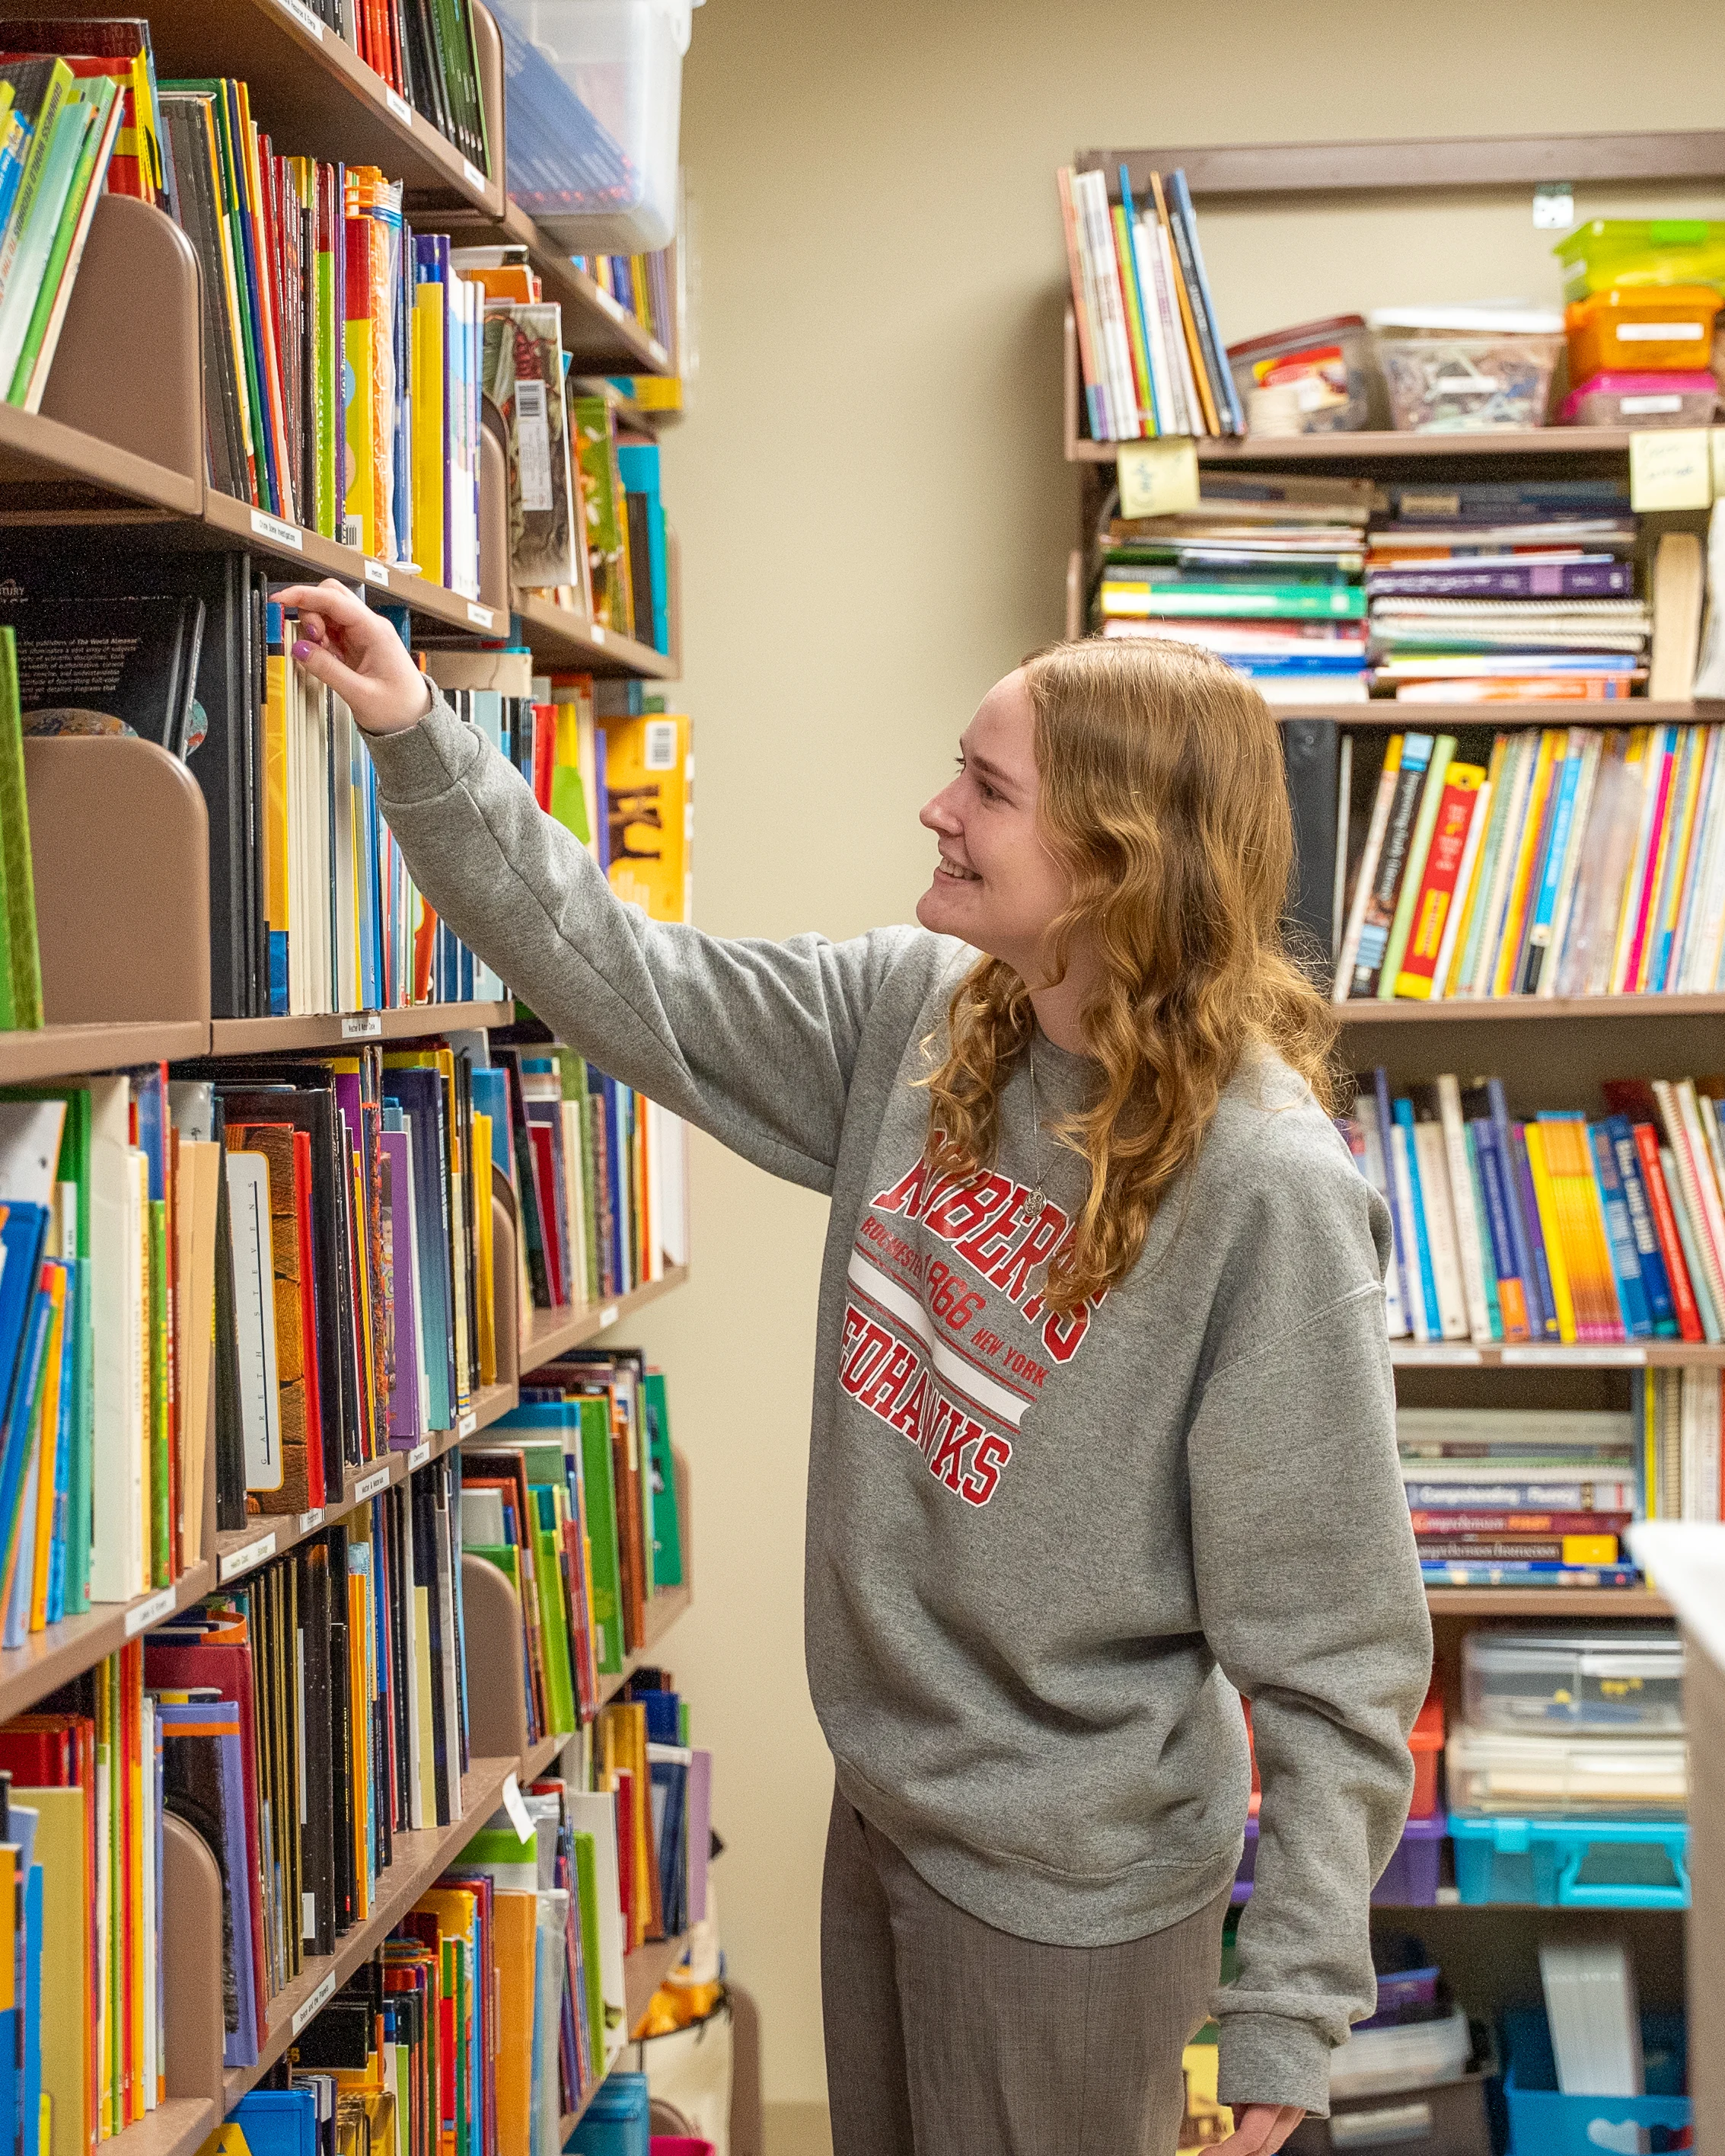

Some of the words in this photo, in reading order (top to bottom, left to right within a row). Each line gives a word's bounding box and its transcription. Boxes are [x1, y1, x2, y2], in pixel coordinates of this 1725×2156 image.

[41, 81, 63, 139] GUINNESS
[29, 138, 46, 180] WORLD
[13, 184, 33, 238] RECORDS
[259, 519, 268, 531] Crime
[269, 521, 277, 534] Scene
[277, 528, 295, 543] Investigations
[0, 587, 24, 596] TURY
[247, 1181, 261, 1318] STEVENS
[859, 1215, 927, 1280] ROCHESTE
[970, 1327, 1004, 1357] NEW
[1002, 1346, 1050, 1389] YORK
[255, 1351, 269, 1466] GARETH
[837, 1296, 1014, 1508] EDHAWKS
[299, 2008, 308, 2022] Space
